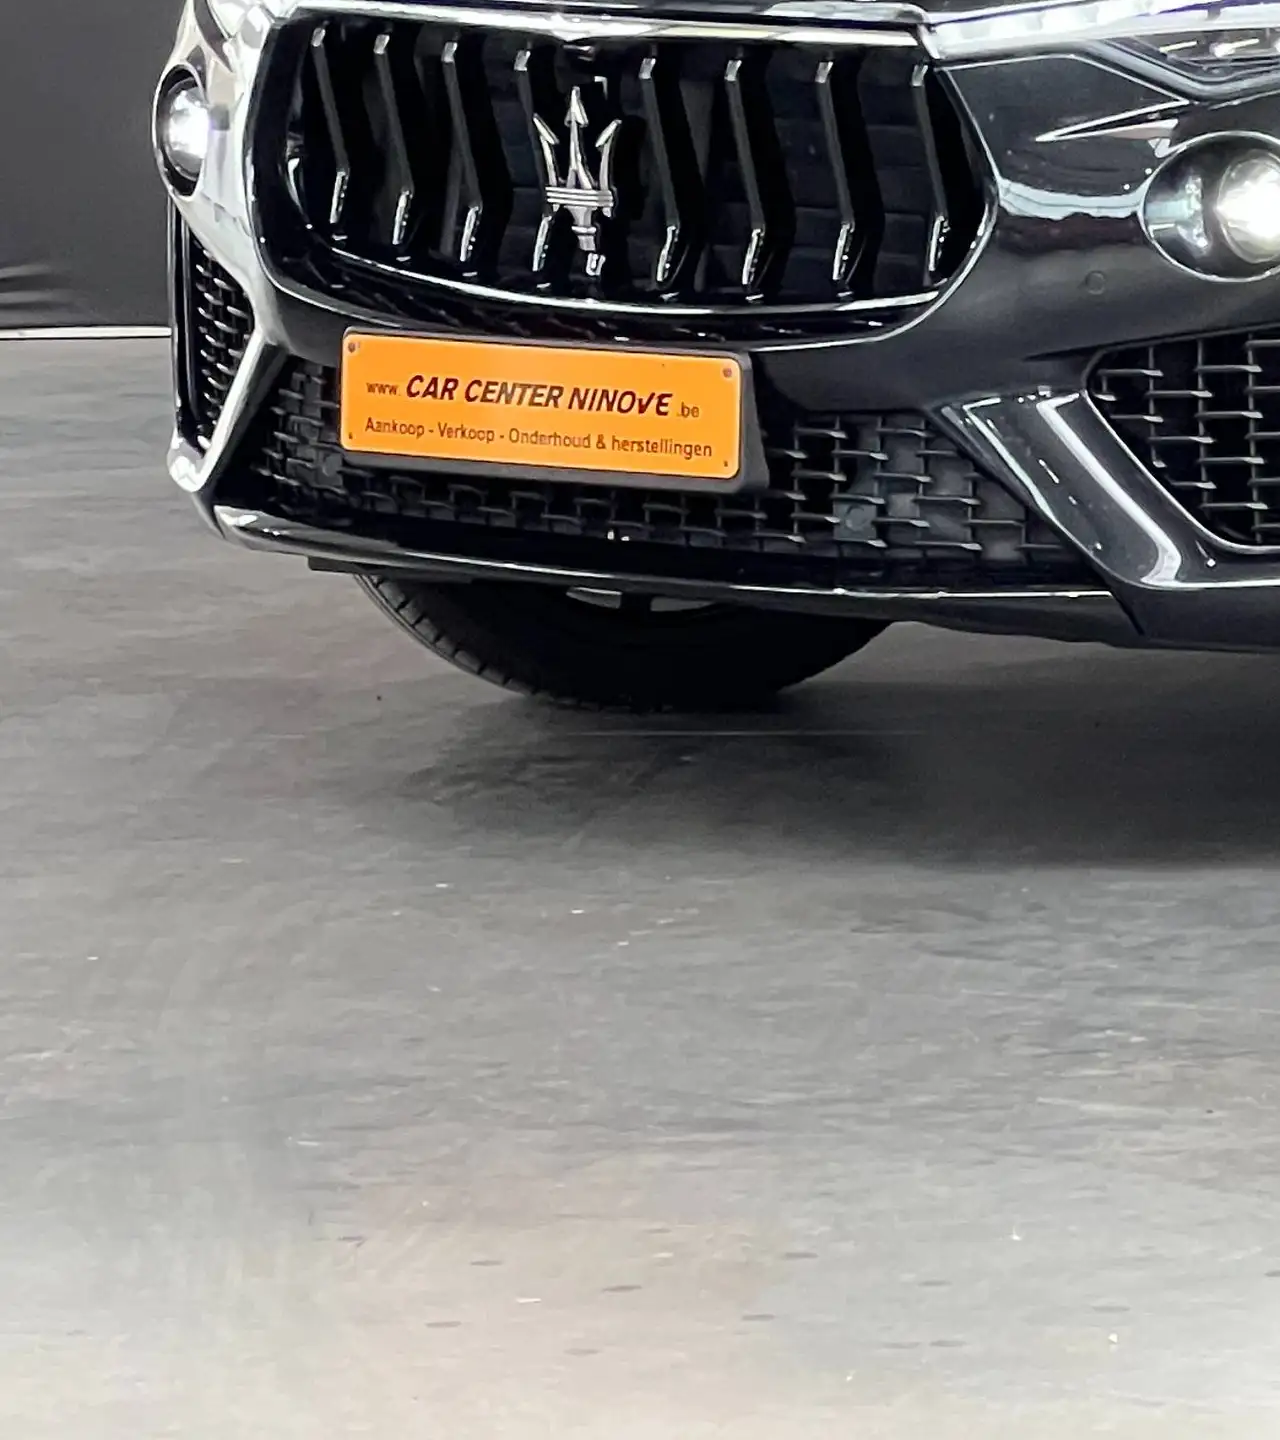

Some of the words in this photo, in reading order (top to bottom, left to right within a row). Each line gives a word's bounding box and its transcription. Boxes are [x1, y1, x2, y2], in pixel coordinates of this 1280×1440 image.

[406, 374, 460, 401] CAR
[464, 379, 565, 409] CENTER
[567, 386, 673, 417] NINOVE
[365, 416, 425, 440] Aankoop
[437, 421, 495, 443] Verkoop
[508, 427, 592, 450] Onderhoud
[595, 433, 607, 450] &
[611, 434, 713, 461] herstellingen
